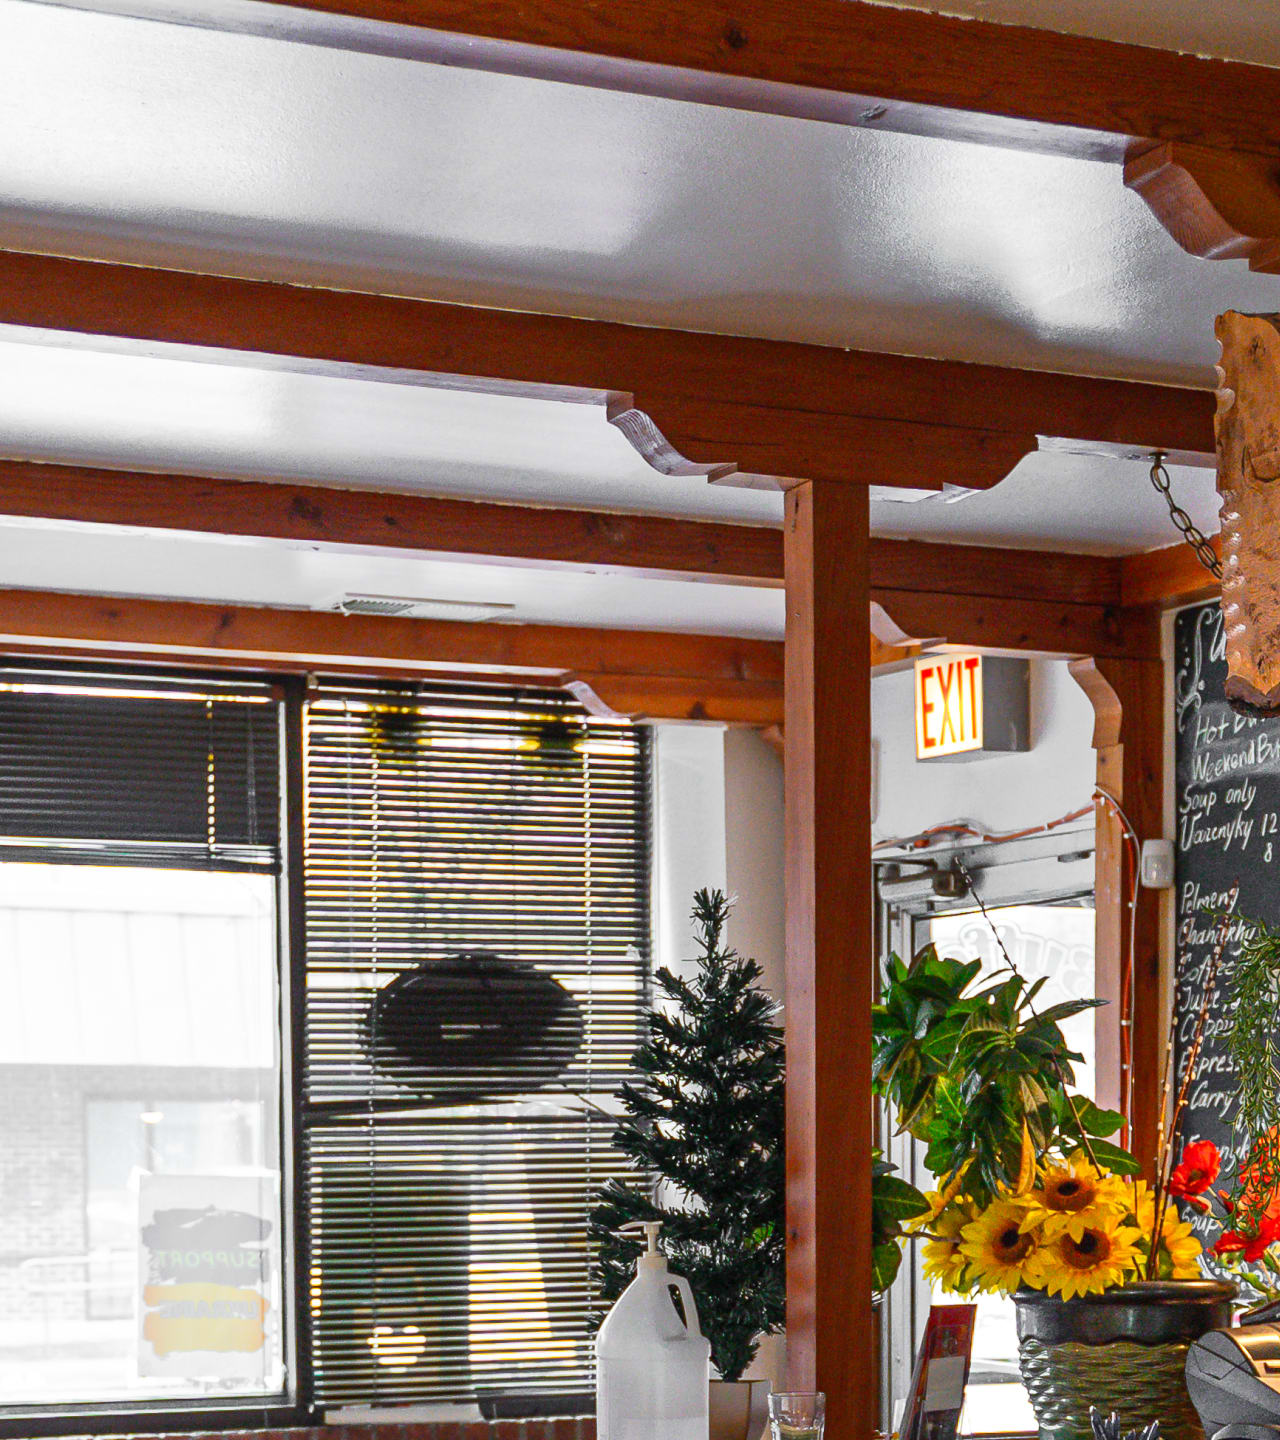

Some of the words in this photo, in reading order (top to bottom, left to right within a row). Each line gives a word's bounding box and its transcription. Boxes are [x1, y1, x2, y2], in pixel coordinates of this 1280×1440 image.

[920, 657, 979, 749] EXIT
[1194, 711, 1229, 751] Hot
[1191, 740, 1256, 783] Weekend
[1179, 782, 1217, 816] Soup
[1225, 777, 1257, 811] only
[1261, 813, 1278, 837] 12
[1263, 841, 1273, 863] 8
